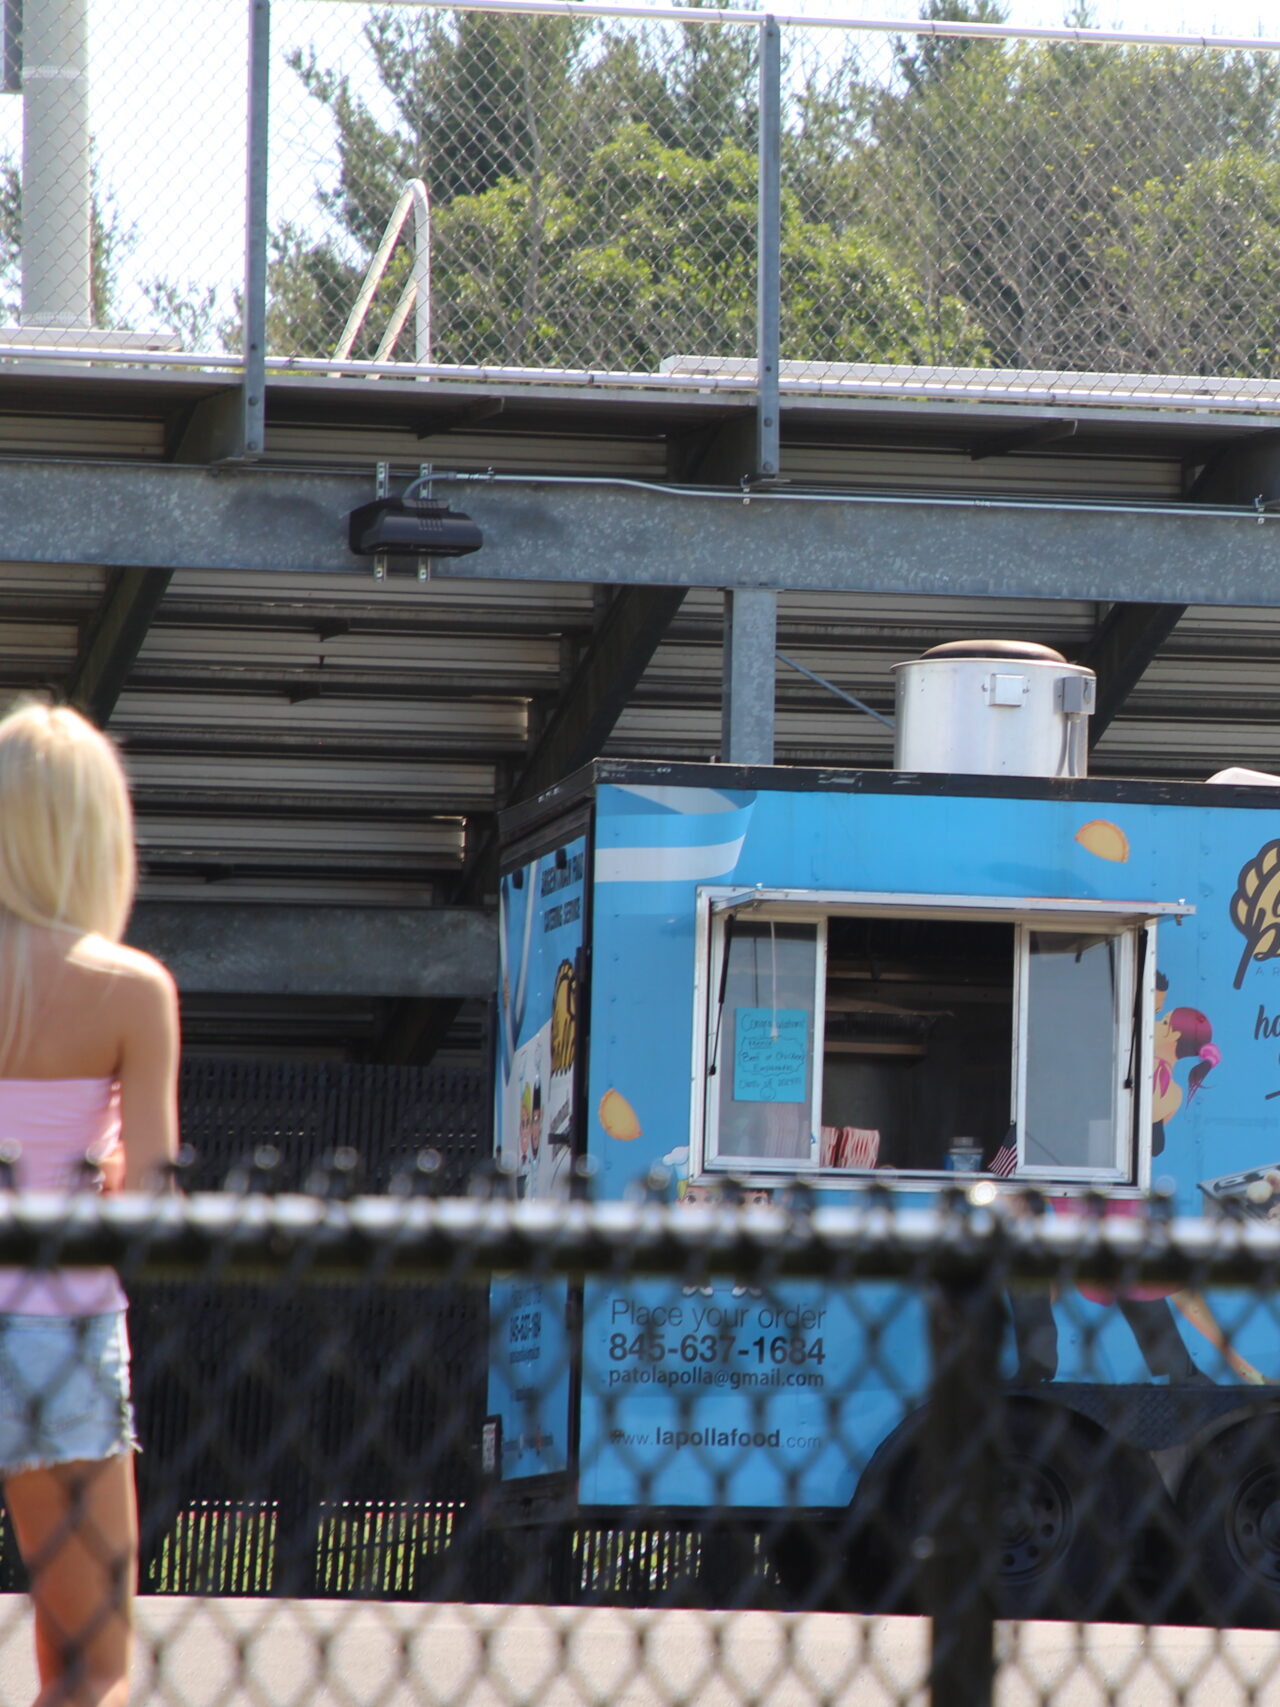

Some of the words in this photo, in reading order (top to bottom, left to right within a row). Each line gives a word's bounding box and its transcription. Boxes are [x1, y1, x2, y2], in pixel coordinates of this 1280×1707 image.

[611, 1299, 683, 1327] Place
[692, 1306, 749, 1332] your
[758, 1304, 827, 1331] order
[609, 1333, 826, 1365] 845-637-1684
[609, 1366, 825, 1389] patolapolla@gmail.com
